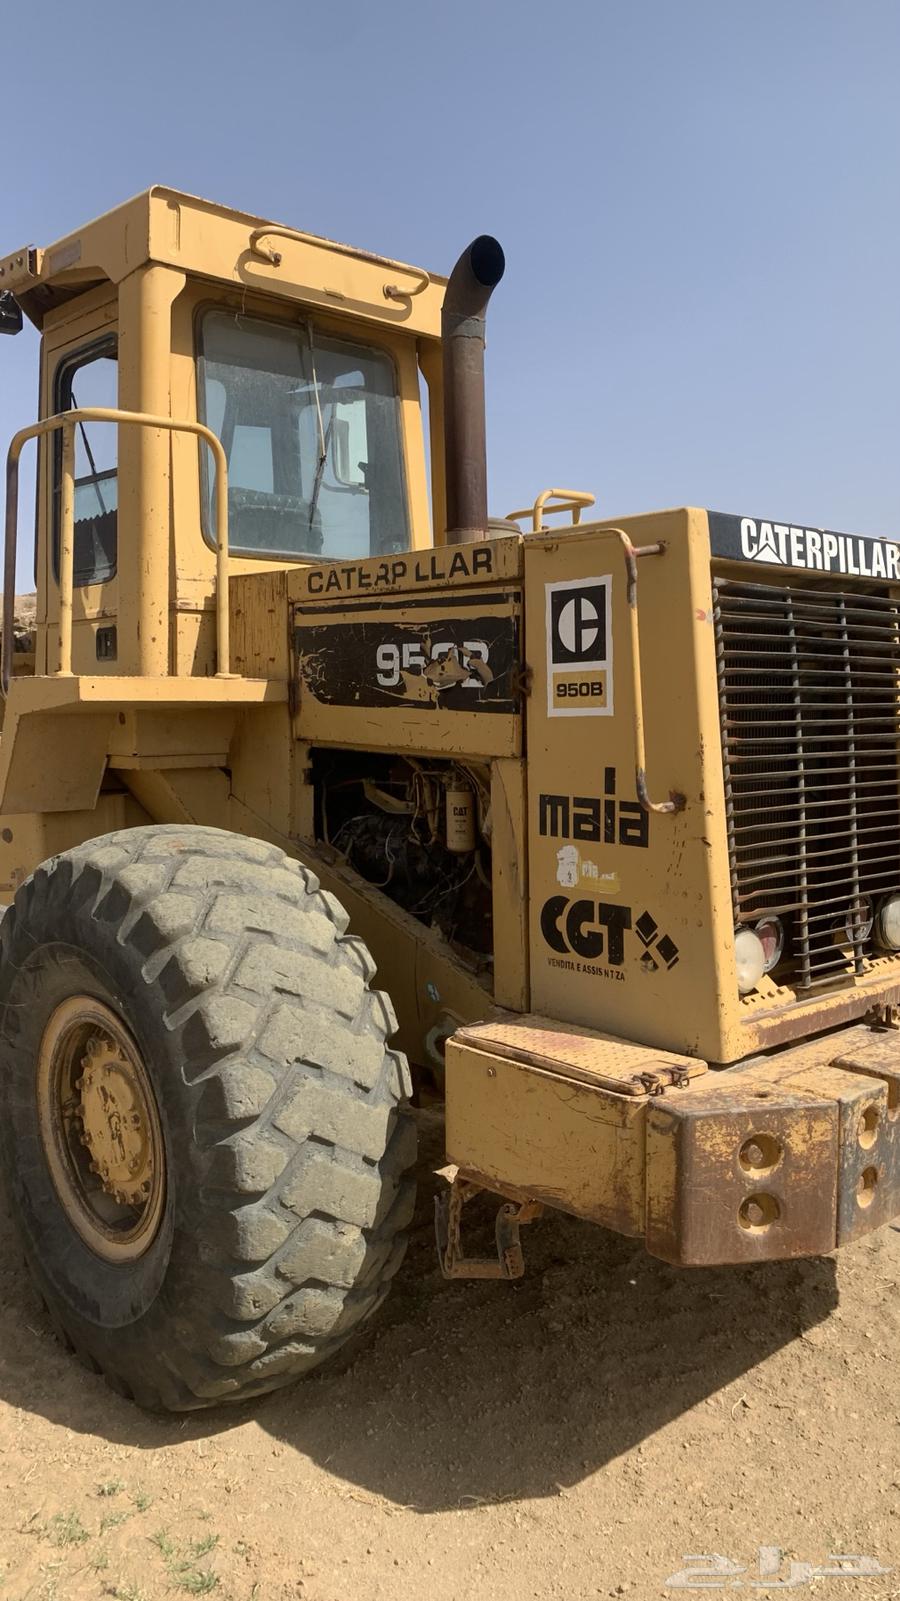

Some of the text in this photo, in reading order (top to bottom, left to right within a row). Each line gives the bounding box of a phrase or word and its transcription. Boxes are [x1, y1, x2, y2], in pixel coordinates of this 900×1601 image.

[556, 681, 603, 698] 950B
[453, 806, 468, 816] CAT
[540, 895, 632, 966] CGT
[576, 963, 581, 972] E
